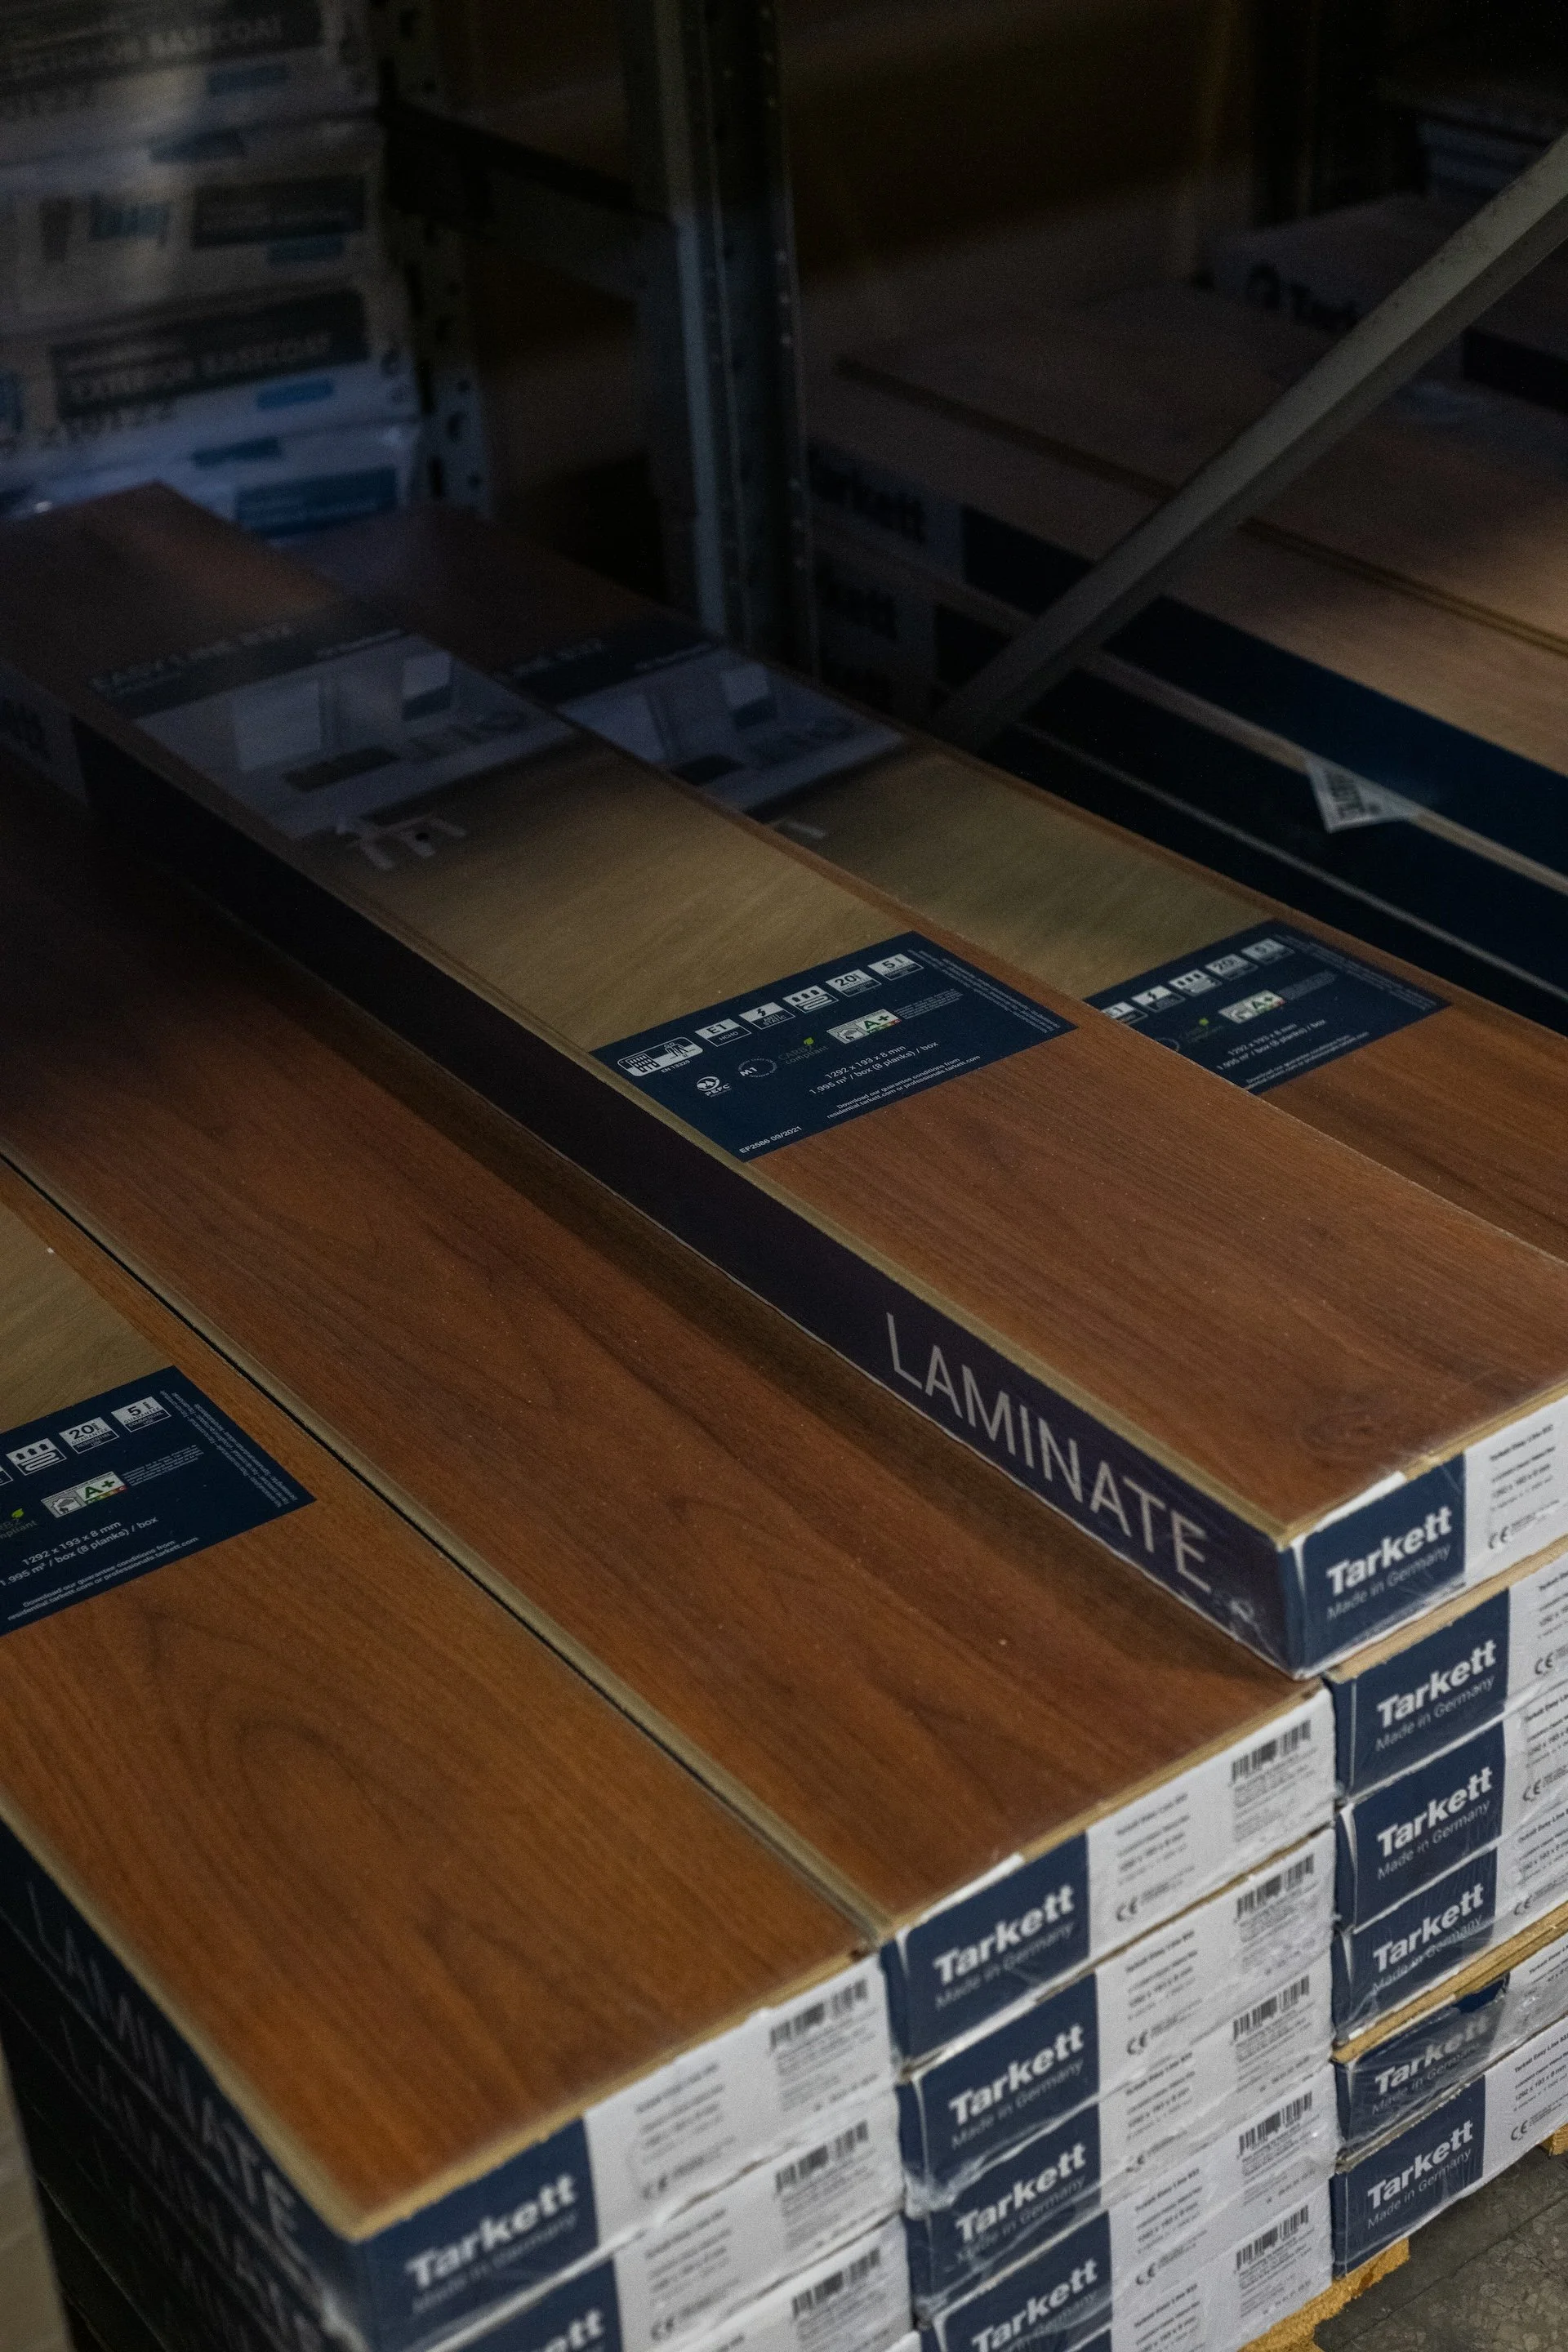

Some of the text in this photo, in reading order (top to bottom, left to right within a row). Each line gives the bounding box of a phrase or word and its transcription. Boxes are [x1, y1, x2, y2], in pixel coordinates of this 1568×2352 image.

[834, 974, 857, 987] 20
[881, 960, 895, 969] 5
[706, 1023, 727, 1034] E1
[863, 1015, 889, 1029] A+
[705, 1084, 729, 1096] PEFC
[739, 1067, 757, 1076] M1
[808, 1081, 835, 1094] 1.995
[853, 1067, 872, 1076] box
[883, 1050, 915, 1067] planks)
[920, 1041, 938, 1050] box
[825, 1067, 849, 1078] 1292
[854, 1057, 873, 1067] 193
[887, 1045, 906, 1054] mm
[836, 1094, 869, 1108] Download
[880, 1077, 912, 1092] guarantee
[912, 1064, 945, 1079] conditions
[943, 1058, 960, 1066] from
[770, 1125, 801, 1141] 09/2021
[69, 1424, 94, 1439] 20
[127, 1405, 141, 1416] 5
[886, 1312, 1212, 1592] LAMINATE
[84, 1480, 114, 1499] A+
[0, 1570, 30, 1585] 1.995
[30, 1561, 45, 1573] m²
[54, 1551, 76, 1563] box
[76, 1544, 89, 1554] (8
[90, 1528, 129, 1549] planks)
[136, 1517, 158, 1528] box
[22, 1550, 50, 1565] 1292
[59, 1537, 81, 1549] 193
[99, 1521, 121, 1533] mm
[22, 1588, 62, 1607] Download
[116, 1548, 156, 1567] conditions
[155, 1540, 175, 1550] from
[1326, 1506, 1452, 1597] Tarkett
[1326, 1544, 1451, 1621] Made in Germany
[1375, 1676, 1494, 1752] Made in Germany
[1376, 1639, 1497, 1728] Tarkett
[1377, 1766, 1494, 1857] Tarkett
[1377, 1799, 1490, 1880] Made in Germany
[933, 1884, 1075, 1985] Tarkett
[1003, 1921, 1075, 1971] Germany
[1373, 1882, 1484, 1973] Tarkett
[27, 1881, 310, 2270] LAMINATE
[949, 2023, 1085, 2124] Tarkett
[998, 2103, 1013, 2118] in
[1016, 2058, 1084, 2109] Germany
[956, 2141, 1086, 2244] Tarkett
[1367, 2119, 1474, 2210] Tarkett
[1367, 2148, 1470, 2230] Made in Germany
[405, 2173, 577, 2290] Tarkett
[970, 2258, 1098, 2352] Tarkett
